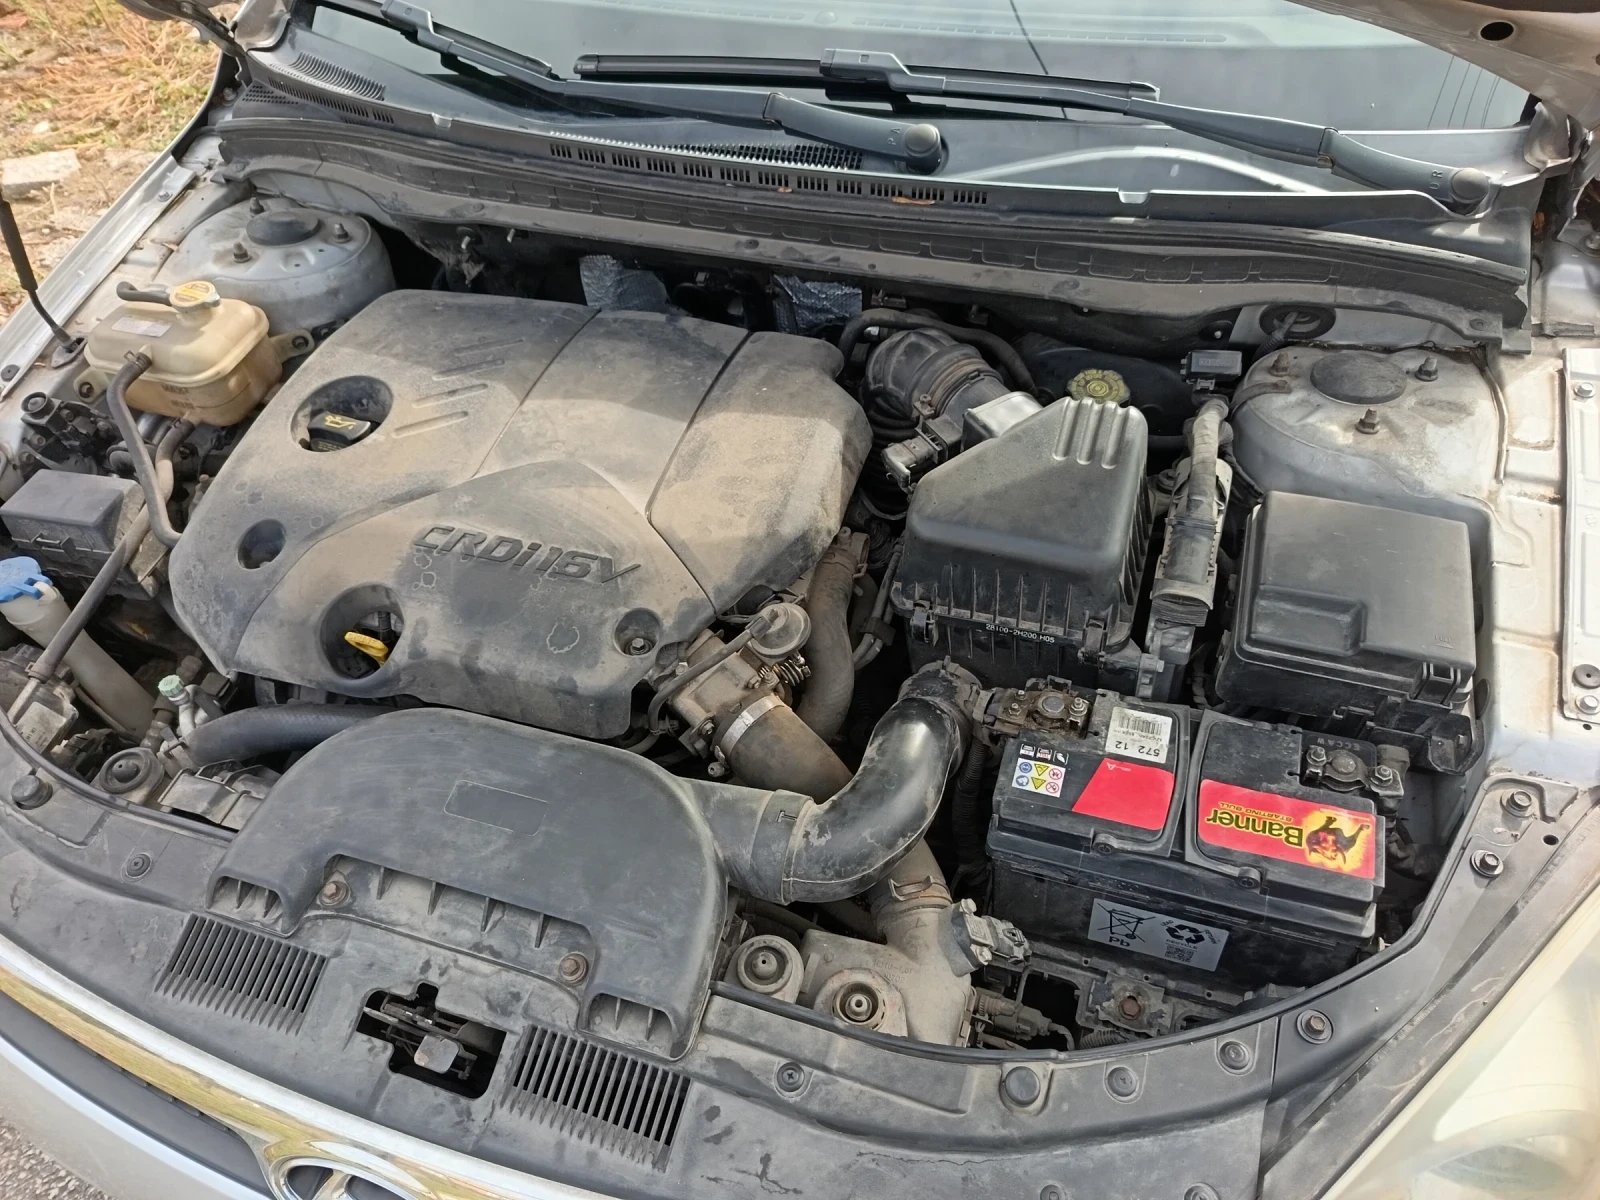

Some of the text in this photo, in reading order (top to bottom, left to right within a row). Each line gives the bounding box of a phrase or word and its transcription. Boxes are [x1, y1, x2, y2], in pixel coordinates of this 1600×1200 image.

[1115, 740, 1160, 757] 572 12
[1219, 802, 1293, 823] STARTING BULL
[1206, 808, 1304, 848] Banner
[1108, 936, 1131, 947] Pb
